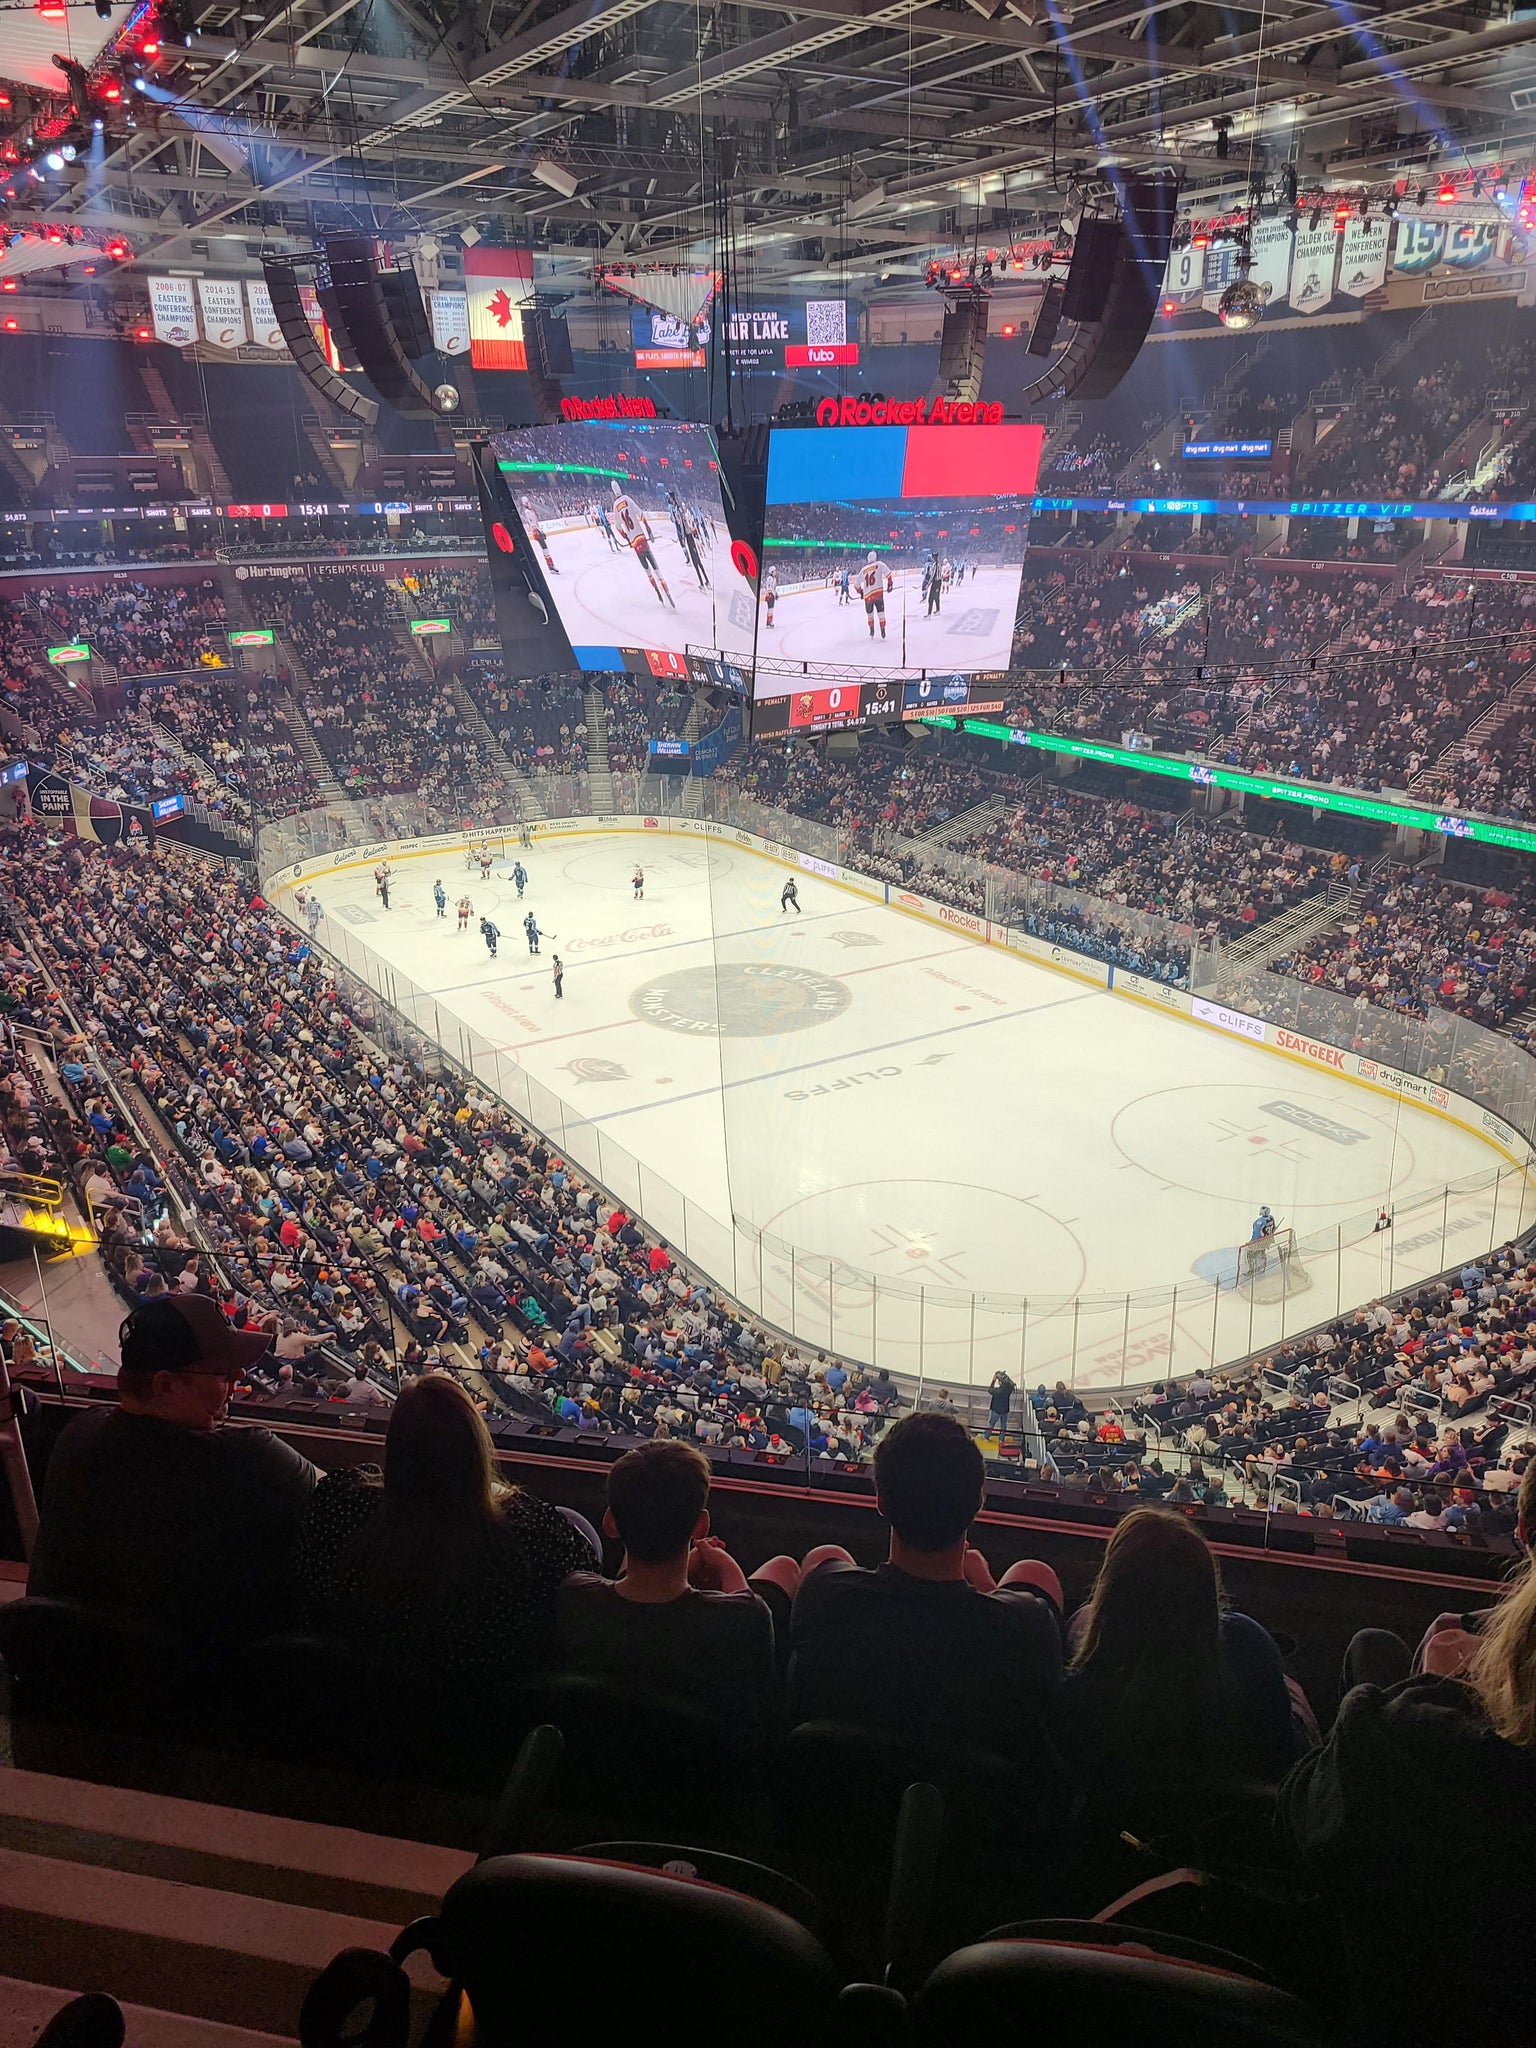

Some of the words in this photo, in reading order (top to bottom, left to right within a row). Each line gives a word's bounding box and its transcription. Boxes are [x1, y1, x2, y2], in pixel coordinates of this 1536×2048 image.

[1253, 231, 1289, 246] CHAMPIONS
[1297, 232, 1323, 246] CALDER
[1323, 230, 1336, 242] CUP
[1351, 226, 1383, 239] WESTERN
[1296, 243, 1335, 259] CHAMPIONS
[1344, 238, 1387, 253] CONFERENCE
[1344, 252, 1383, 265] CHAMPIONS
[1180, 255, 1191, 286] 9
[155, 282, 186, 292] 2006-07
[205, 285, 236, 295] 2014-15
[158, 294, 187, 304] EASTERN
[208, 296, 236, 306] EASTERN
[256, 298, 272, 306] EAST
[154, 303, 194, 313] CONFERENCE
[204, 306, 242, 315] CONFERENCE
[433, 301, 465, 310] CHAMPIONS
[157, 313, 194, 323] CHAMPIONS
[207, 315, 242, 325] CHAMPIONS
[255, 316, 276, 325] CHAMP
[731, 312, 752, 322] HELP
[752, 311, 778, 322] CLEAN
[754, 320, 790, 341] LAKE
[808, 350, 835, 362] fubo
[618, 393, 657, 418] Arena
[840, 395, 926, 425] Rocket
[928, 395, 1004, 424] Arena
[146, 509, 167, 517] SHOTS
[172, 507, 180, 517] 2
[216, 506, 223, 516] 0
[262, 505, 271, 516] 0
[299, 504, 329, 516] 15:41
[374, 502, 382, 514] 0
[414, 503, 433, 512] SHOTS
[437, 502, 444, 512] 0
[1289, 503, 1368, 514] SPITZER
[1380, 504, 1414, 515] VIP
[249, 564, 304, 579] Huntington
[314, 564, 358, 575] LEGENDS
[360, 562, 385, 573] CLUB
[864, 571, 876, 587] 16
[668, 653, 678, 669] 0
[919, 679, 932, 698] 0
[829, 688, 841, 709] 0
[865, 700, 896, 716] 15:41
[925, 709, 936, 717] $10
[945, 707, 955, 715] FOR
[956, 706, 968, 714] $20
[832, 720, 845, 729] TOTAL
[2, 771, 9, 783] 2
[40, 795, 50, 803] IN
[50, 794, 69, 803] THE
[1271, 786, 1330, 804] SPITZER.PROMO
[42, 802, 70, 811] PAINT
[468, 829, 484, 838] HITS
[485, 826, 512, 836] HAPPEN
[693, 822, 722, 834] CLIFFS
[362, 843, 388, 860] Culver's
[400, 842, 419, 850] NOPEC
[333, 848, 358, 866] Culver's
[813, 861, 836, 876] CLIFFS
[947, 911, 982, 933] Rocket
[564, 922, 675, 953] Coca-Cola
[743, 966, 840, 1011] CLEVELAND
[641, 988, 728, 1032] MONSTERS
[1218, 1012, 1263, 1036] CLIFFS
[1276, 1029, 1346, 1071] SEATGEEK
[1360, 1060, 1376, 1072] drug
[784, 1066, 903, 1102] CLIFFS
[1379, 1069, 1402, 1087] drug
[1403, 1080, 1428, 1096] mart
[1430, 1087, 1447, 1101] drug
